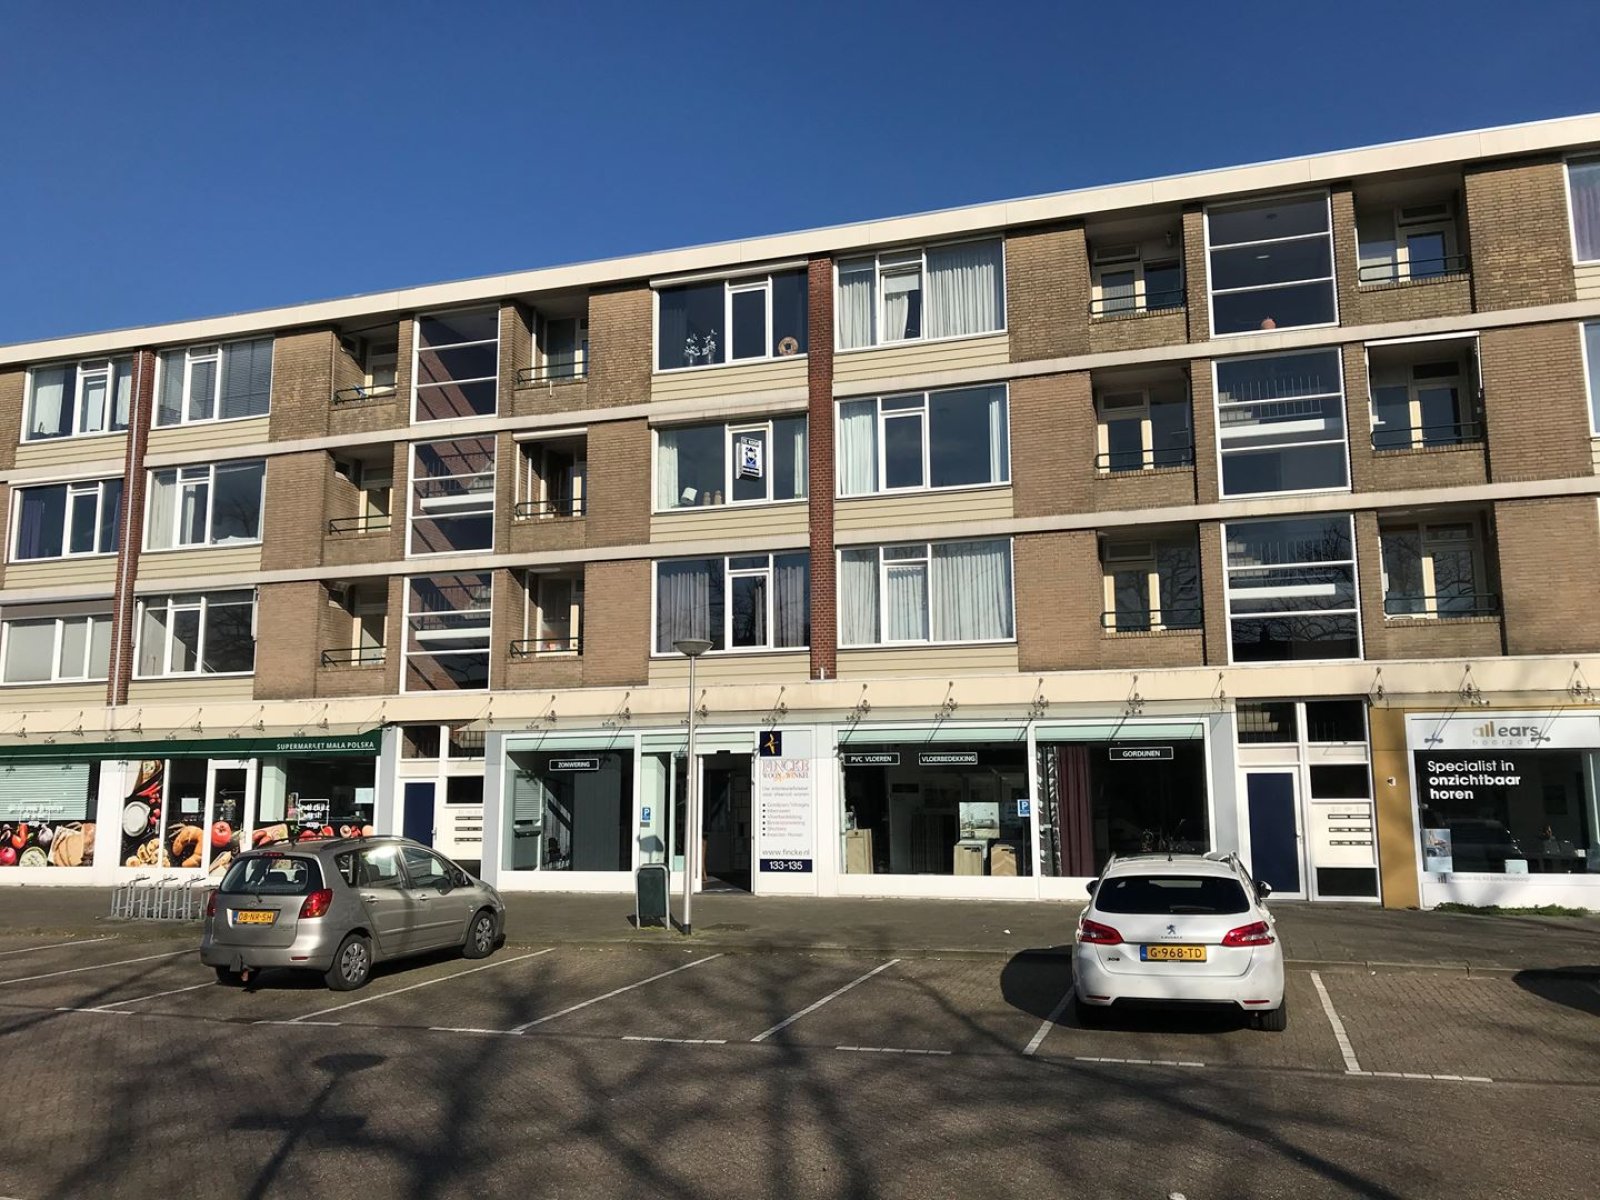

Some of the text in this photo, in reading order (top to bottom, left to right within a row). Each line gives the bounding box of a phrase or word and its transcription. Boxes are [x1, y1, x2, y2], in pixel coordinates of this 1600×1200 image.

[1473, 720, 1539, 737] all ears
[276, 742, 324, 750] SUPERMARKET
[1122, 749, 1161, 758] GORDIJNEN
[850, 755, 892, 763] PVC VLOEREN
[921, 755, 976, 763] VLOERBEDEKKING
[1427, 760, 1514, 774] Specialist in
[1429, 774, 1521, 786] onzichtbaar
[1430, 788, 1474, 800] horen
[1021, 801, 1028, 810] P
[769, 860, 803, 870] 133-135
[1150, 947, 1202, 958] G-968-TD
